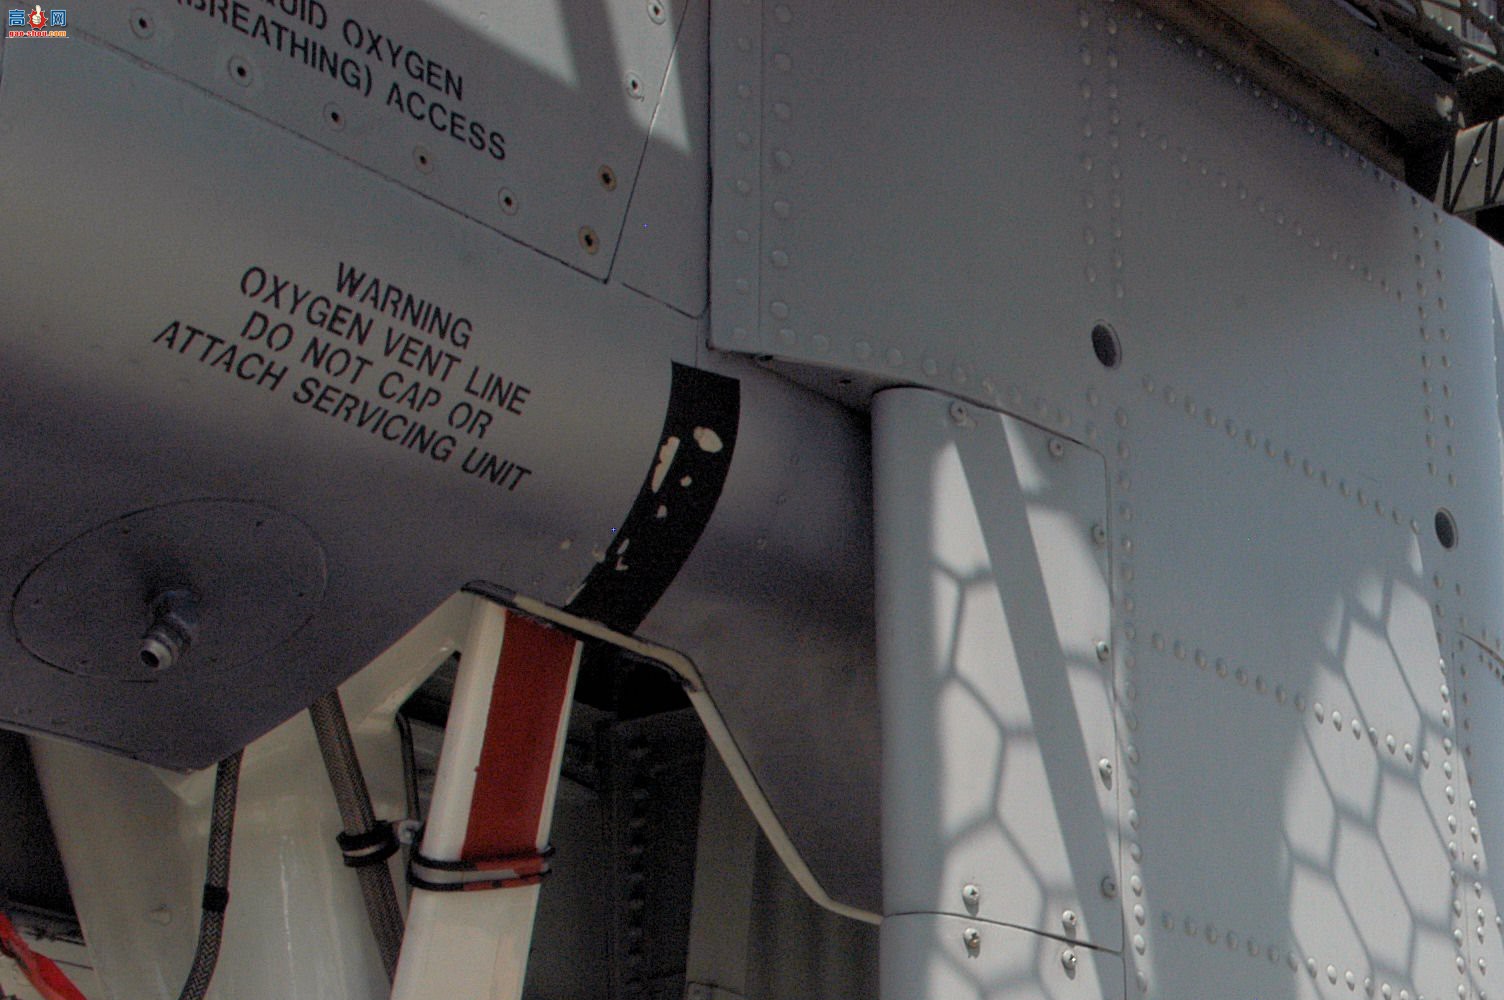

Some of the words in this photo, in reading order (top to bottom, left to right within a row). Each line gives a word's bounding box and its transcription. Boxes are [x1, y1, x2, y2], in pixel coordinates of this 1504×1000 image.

[177, 0, 373, 97] REATHING)
[386, 82, 506, 161] ACCESS
[266, 0, 328, 31] UID
[342, 18, 464, 101] OXYGEN
[240, 266, 375, 346] OXYGEN
[382, 326, 462, 382] VENT
[464, 365, 532, 416] LINE
[240, 310, 295, 352] DO
[299, 337, 374, 386] NOT
[377, 371, 442, 413] CAP
[447, 401, 494, 440] OR
[335, 261, 473, 350] WARNING
[152, 320, 289, 391] ATTACH
[292, 376, 458, 464] SERVICING
[460, 446, 533, 492] UNIT
